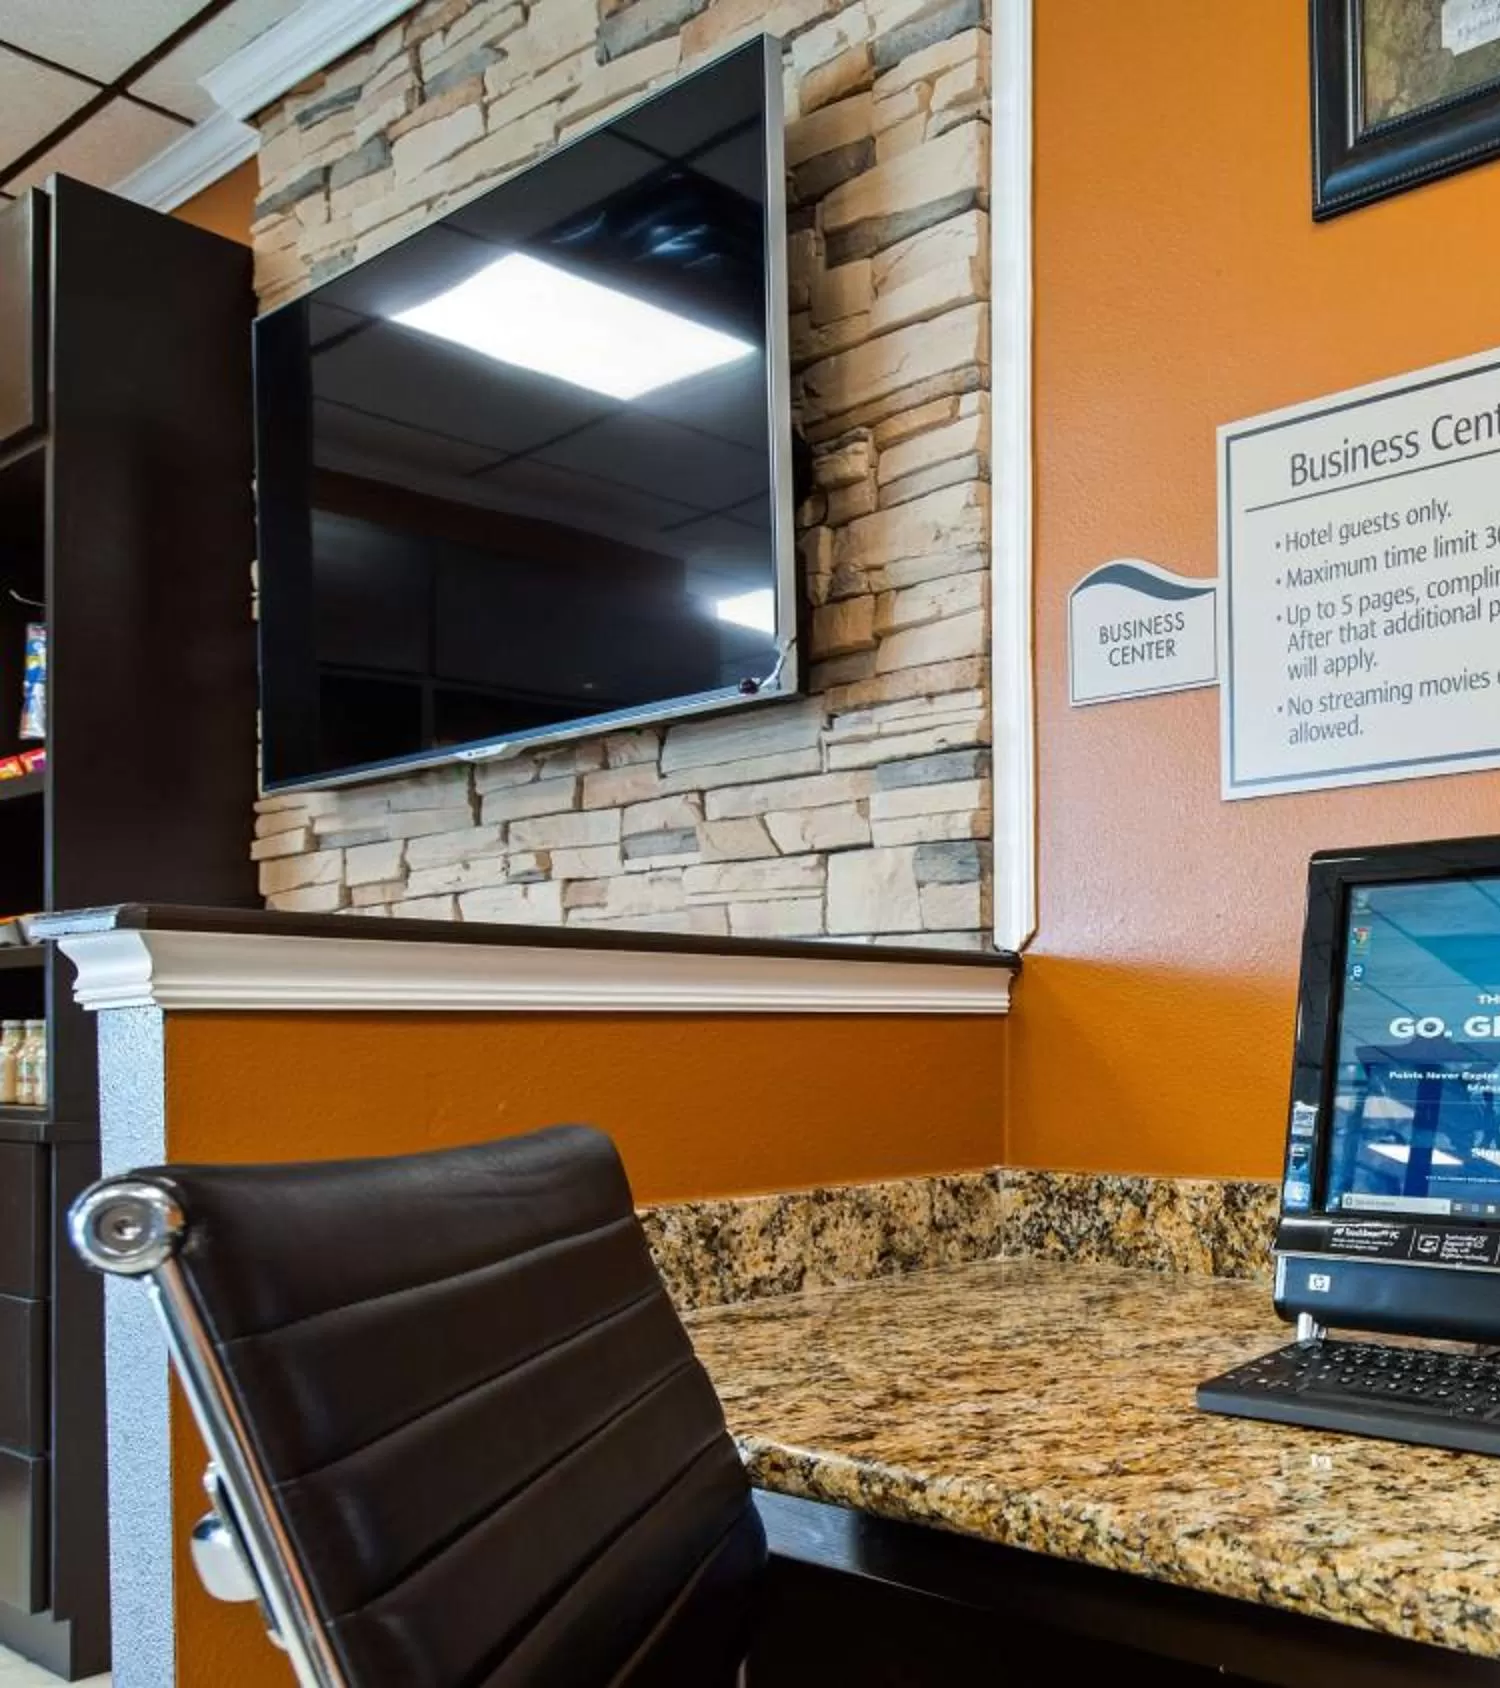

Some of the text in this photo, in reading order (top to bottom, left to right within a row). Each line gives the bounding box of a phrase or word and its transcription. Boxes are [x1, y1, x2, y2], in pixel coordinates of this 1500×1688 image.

[1290, 430, 1421, 487] Business
[1285, 497, 1453, 553] Hotel guests only.
[1286, 555, 1378, 588] Maximum
[1384, 543, 1428, 569] time
[1434, 529, 1479, 559] limit
[1286, 604, 1312, 629] Up
[1316, 600, 1336, 620] to
[1341, 593, 1353, 616] 5
[1358, 585, 1421, 617] pages,
[1287, 629, 1333, 653] After
[1338, 619, 1377, 645] that
[1383, 597, 1482, 637] additional
[1098, 611, 1186, 645] BUSINESS
[1108, 639, 1178, 667] CENTER
[1287, 647, 1378, 681] will apply.
[1287, 696, 1313, 717] No
[1319, 681, 1413, 713] streaming
[1418, 667, 1491, 698] movies
[1288, 713, 1364, 745] allowed.
[1388, 1015, 1453, 1039] GO.
[1388, 1071, 1424, 1080] Points
[1426, 1071, 1459, 1080] Never
[1462, 1071, 1499, 1082] Expire
